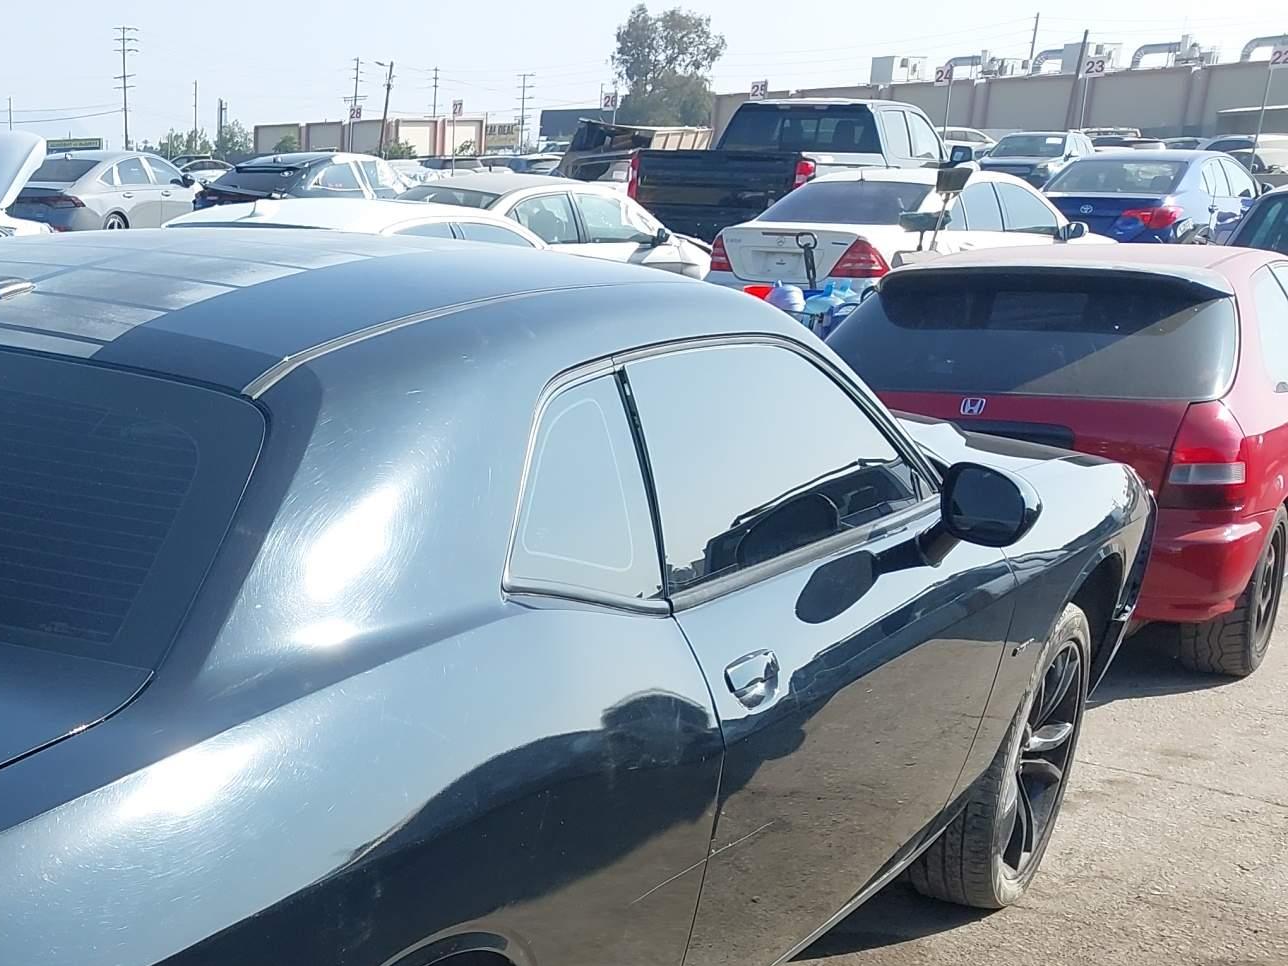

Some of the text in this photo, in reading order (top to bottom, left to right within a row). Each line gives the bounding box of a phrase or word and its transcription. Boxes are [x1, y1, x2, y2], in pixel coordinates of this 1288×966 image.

[1085, 59, 1105, 74] 23
[935, 68, 952, 83] 24
[751, 84, 767, 97] 25
[349, 108, 362, 119] 28
[452, 103, 463, 115] 27
